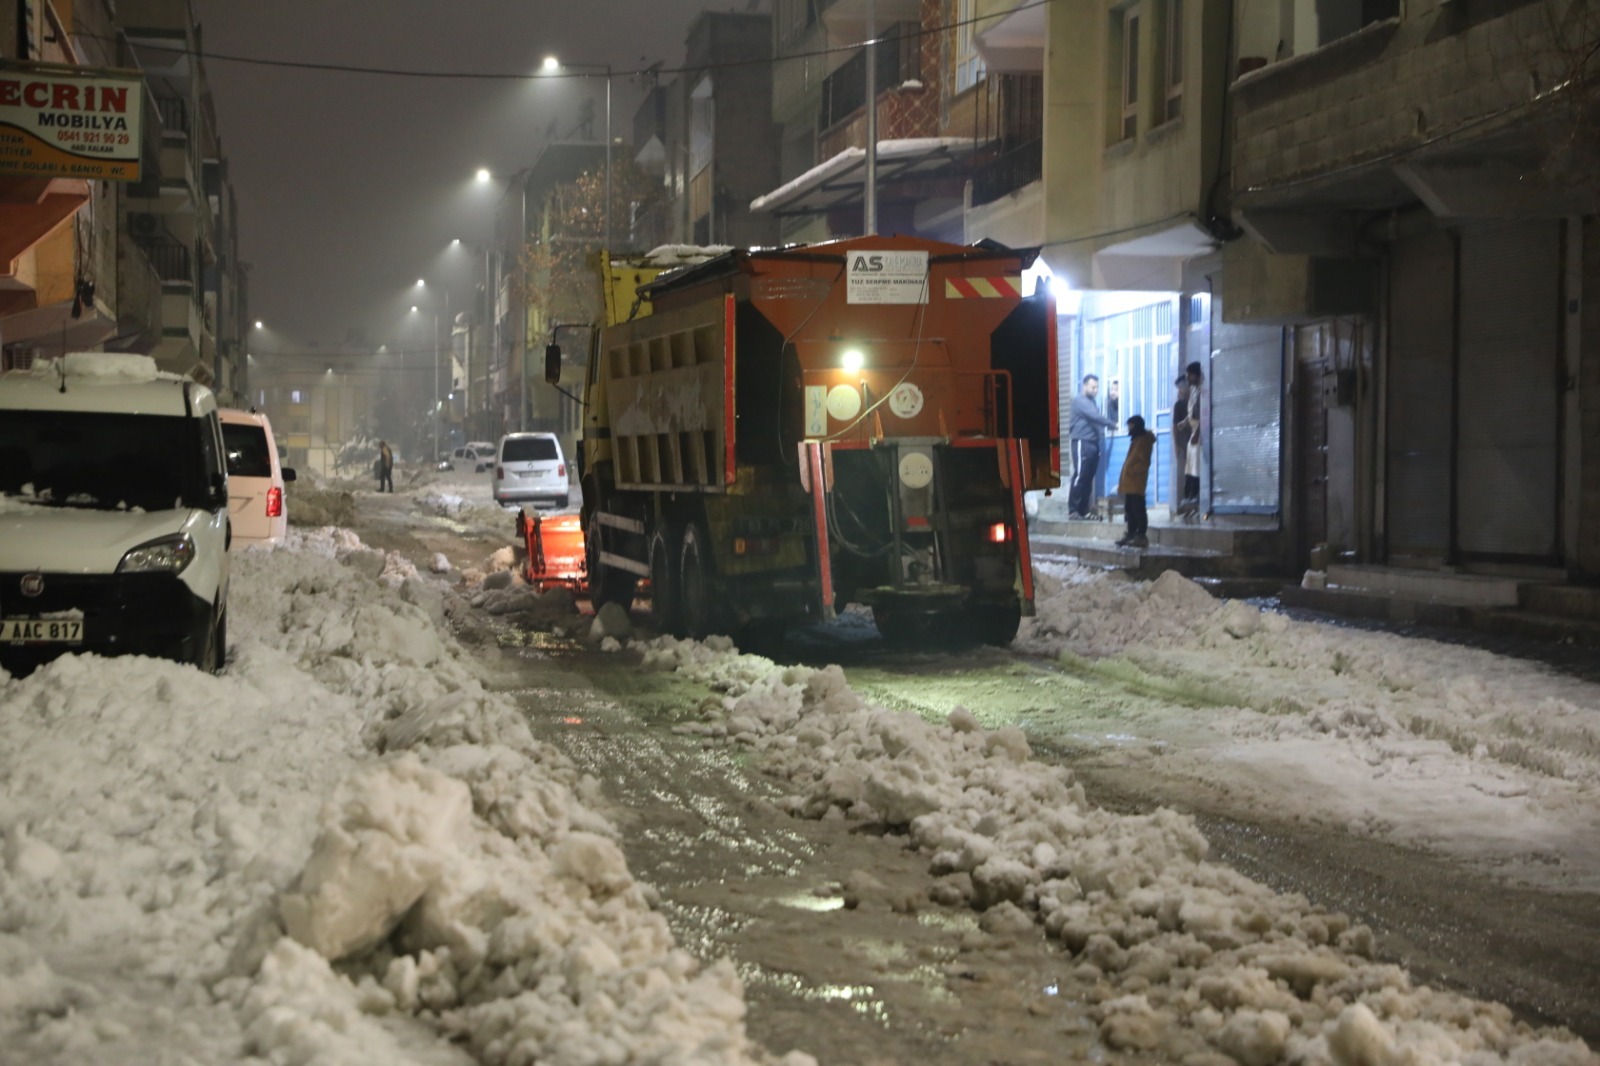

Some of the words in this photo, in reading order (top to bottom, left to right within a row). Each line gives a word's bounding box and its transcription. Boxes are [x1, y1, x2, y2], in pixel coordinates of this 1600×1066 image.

[57, 130, 80, 141] 0541
[83, 132, 100, 143] 921
[111, 166, 125, 176] WC
[852, 256, 884, 272] AS
[12, 623, 42, 638] AAC
[50, 623, 80, 638] 817
